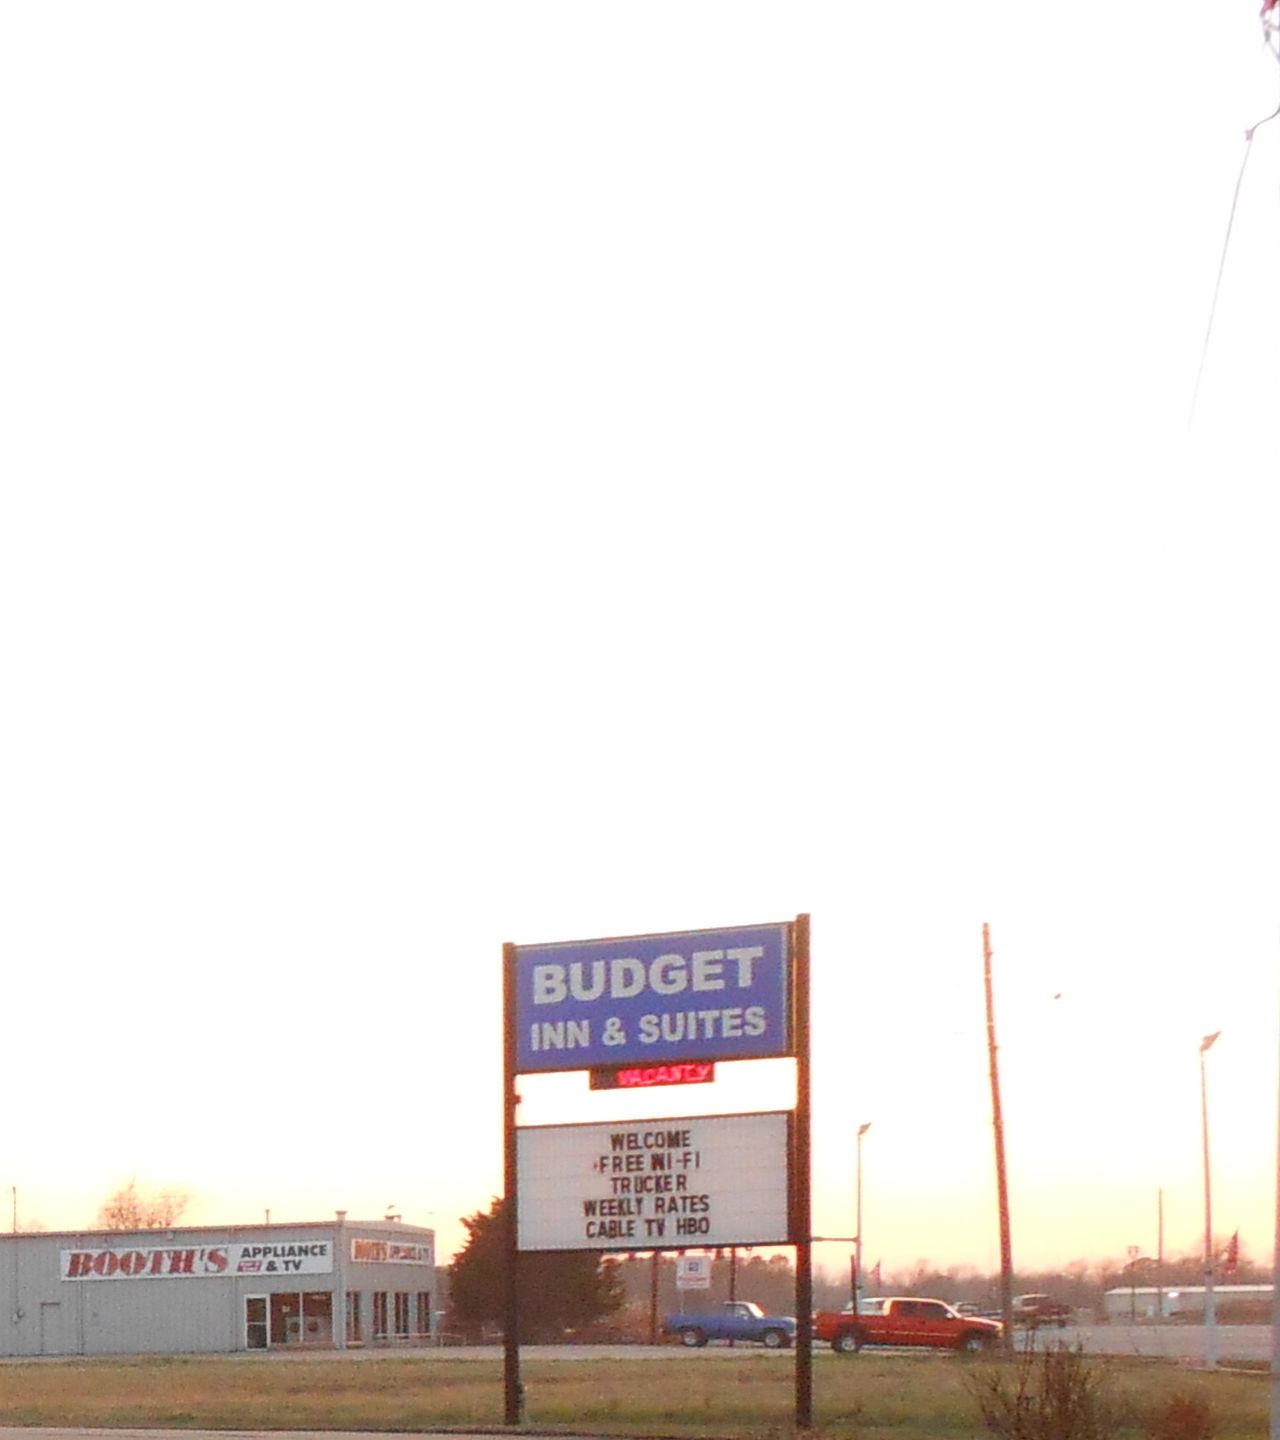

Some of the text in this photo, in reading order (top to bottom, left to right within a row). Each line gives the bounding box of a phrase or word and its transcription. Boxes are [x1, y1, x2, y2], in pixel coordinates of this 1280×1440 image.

[533, 947, 764, 1005] BUDGET
[531, 1006, 766, 1051] INN & SUITES
[610, 1130, 691, 1151] WELCOME
[651, 1151, 700, 1171] WI-FI
[610, 1174, 687, 1194] TRUCKER
[584, 1194, 710, 1217] WEEKLY RATES
[586, 1216, 710, 1239] CABLE TV HBO
[241, 1244, 327, 1258] APPLIANCE
[66, 1248, 229, 1278] BOOTH'S
[266, 1261, 278, 1272] &
[284, 1260, 302, 1271] TV
